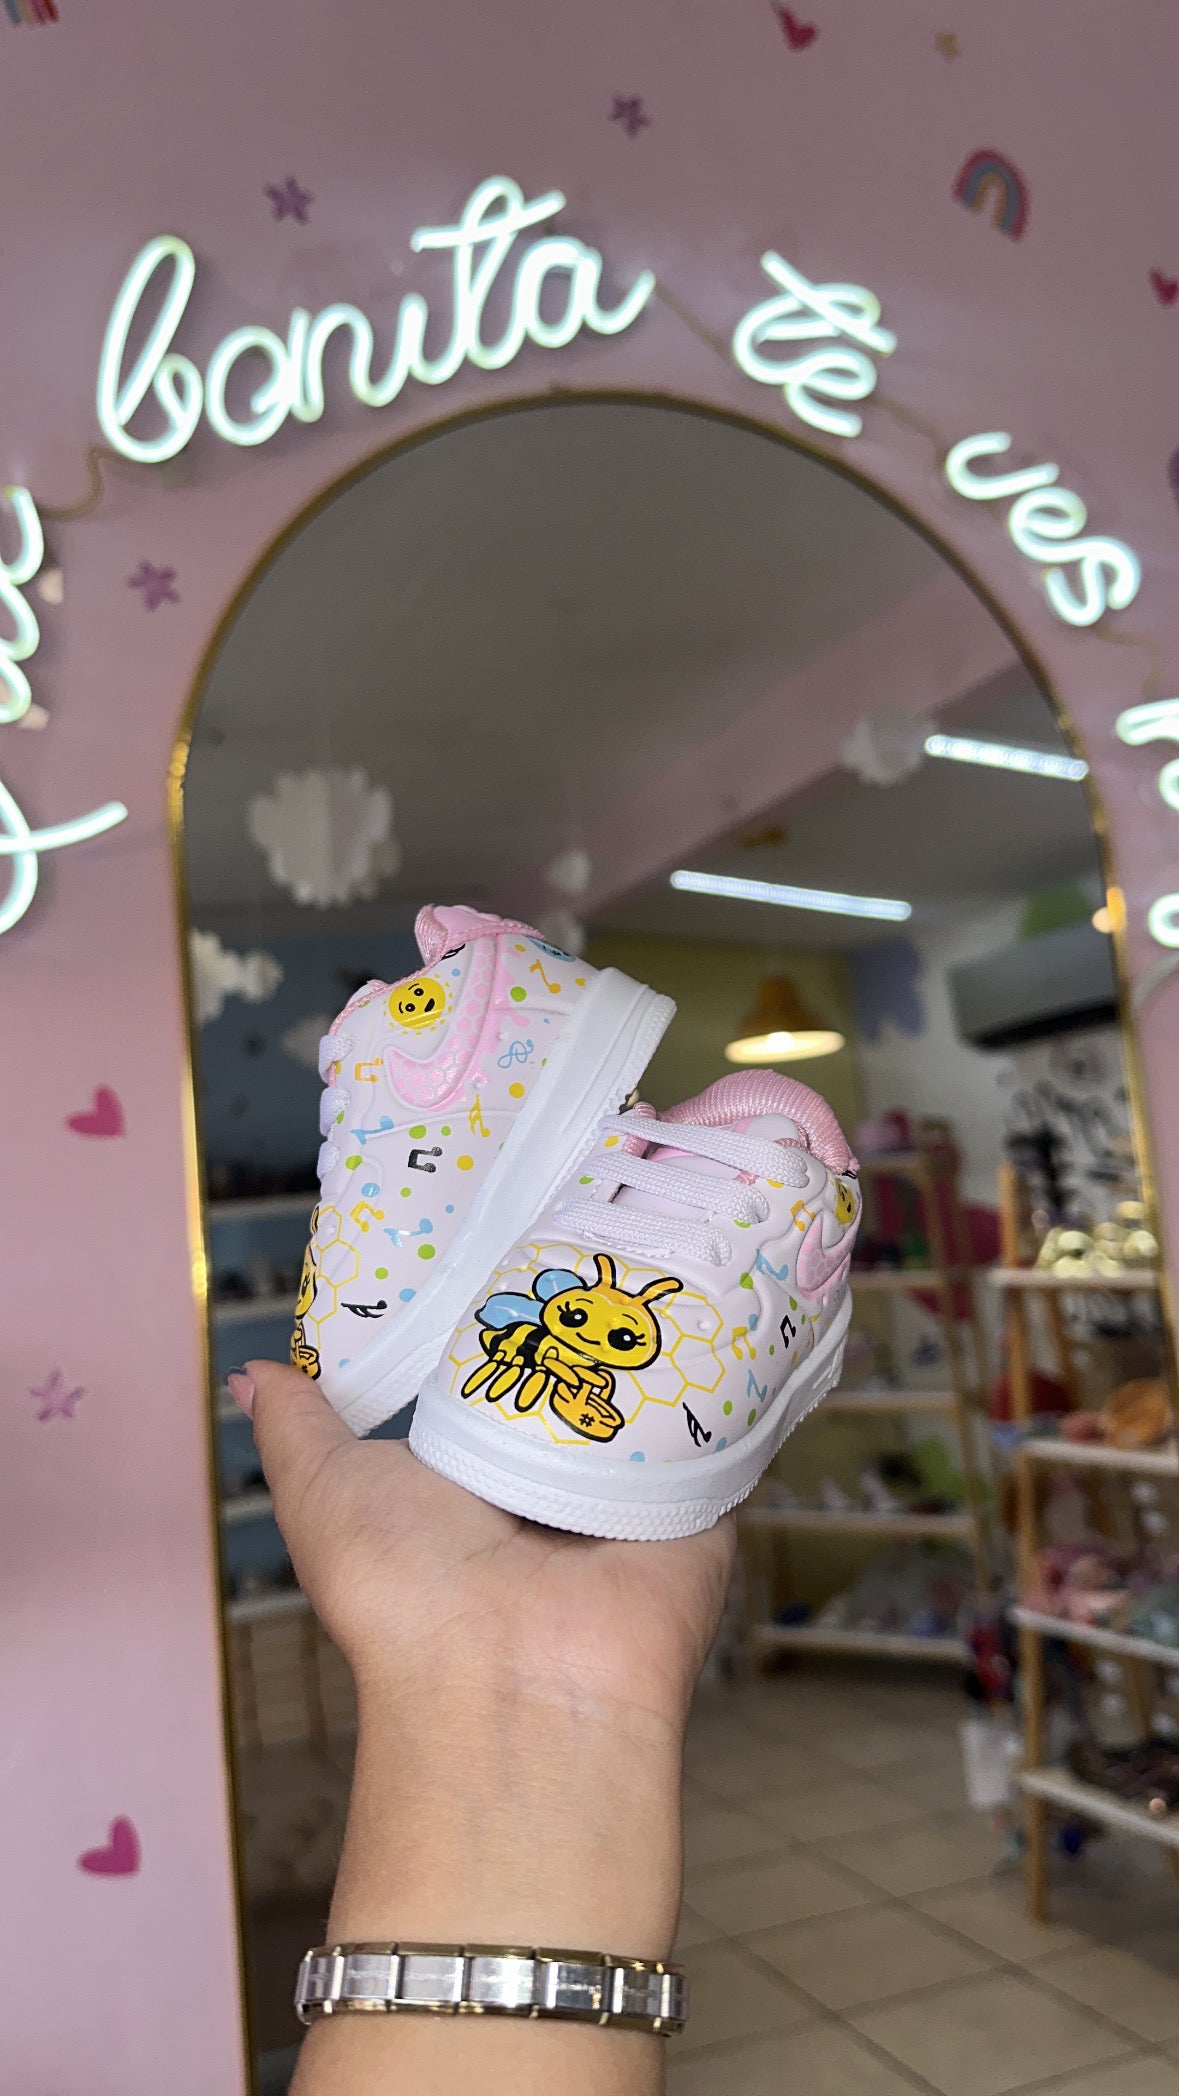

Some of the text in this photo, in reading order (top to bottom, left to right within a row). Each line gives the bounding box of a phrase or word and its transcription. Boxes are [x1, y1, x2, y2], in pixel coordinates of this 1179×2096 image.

[96, 176, 1141, 626] bonita te ves
